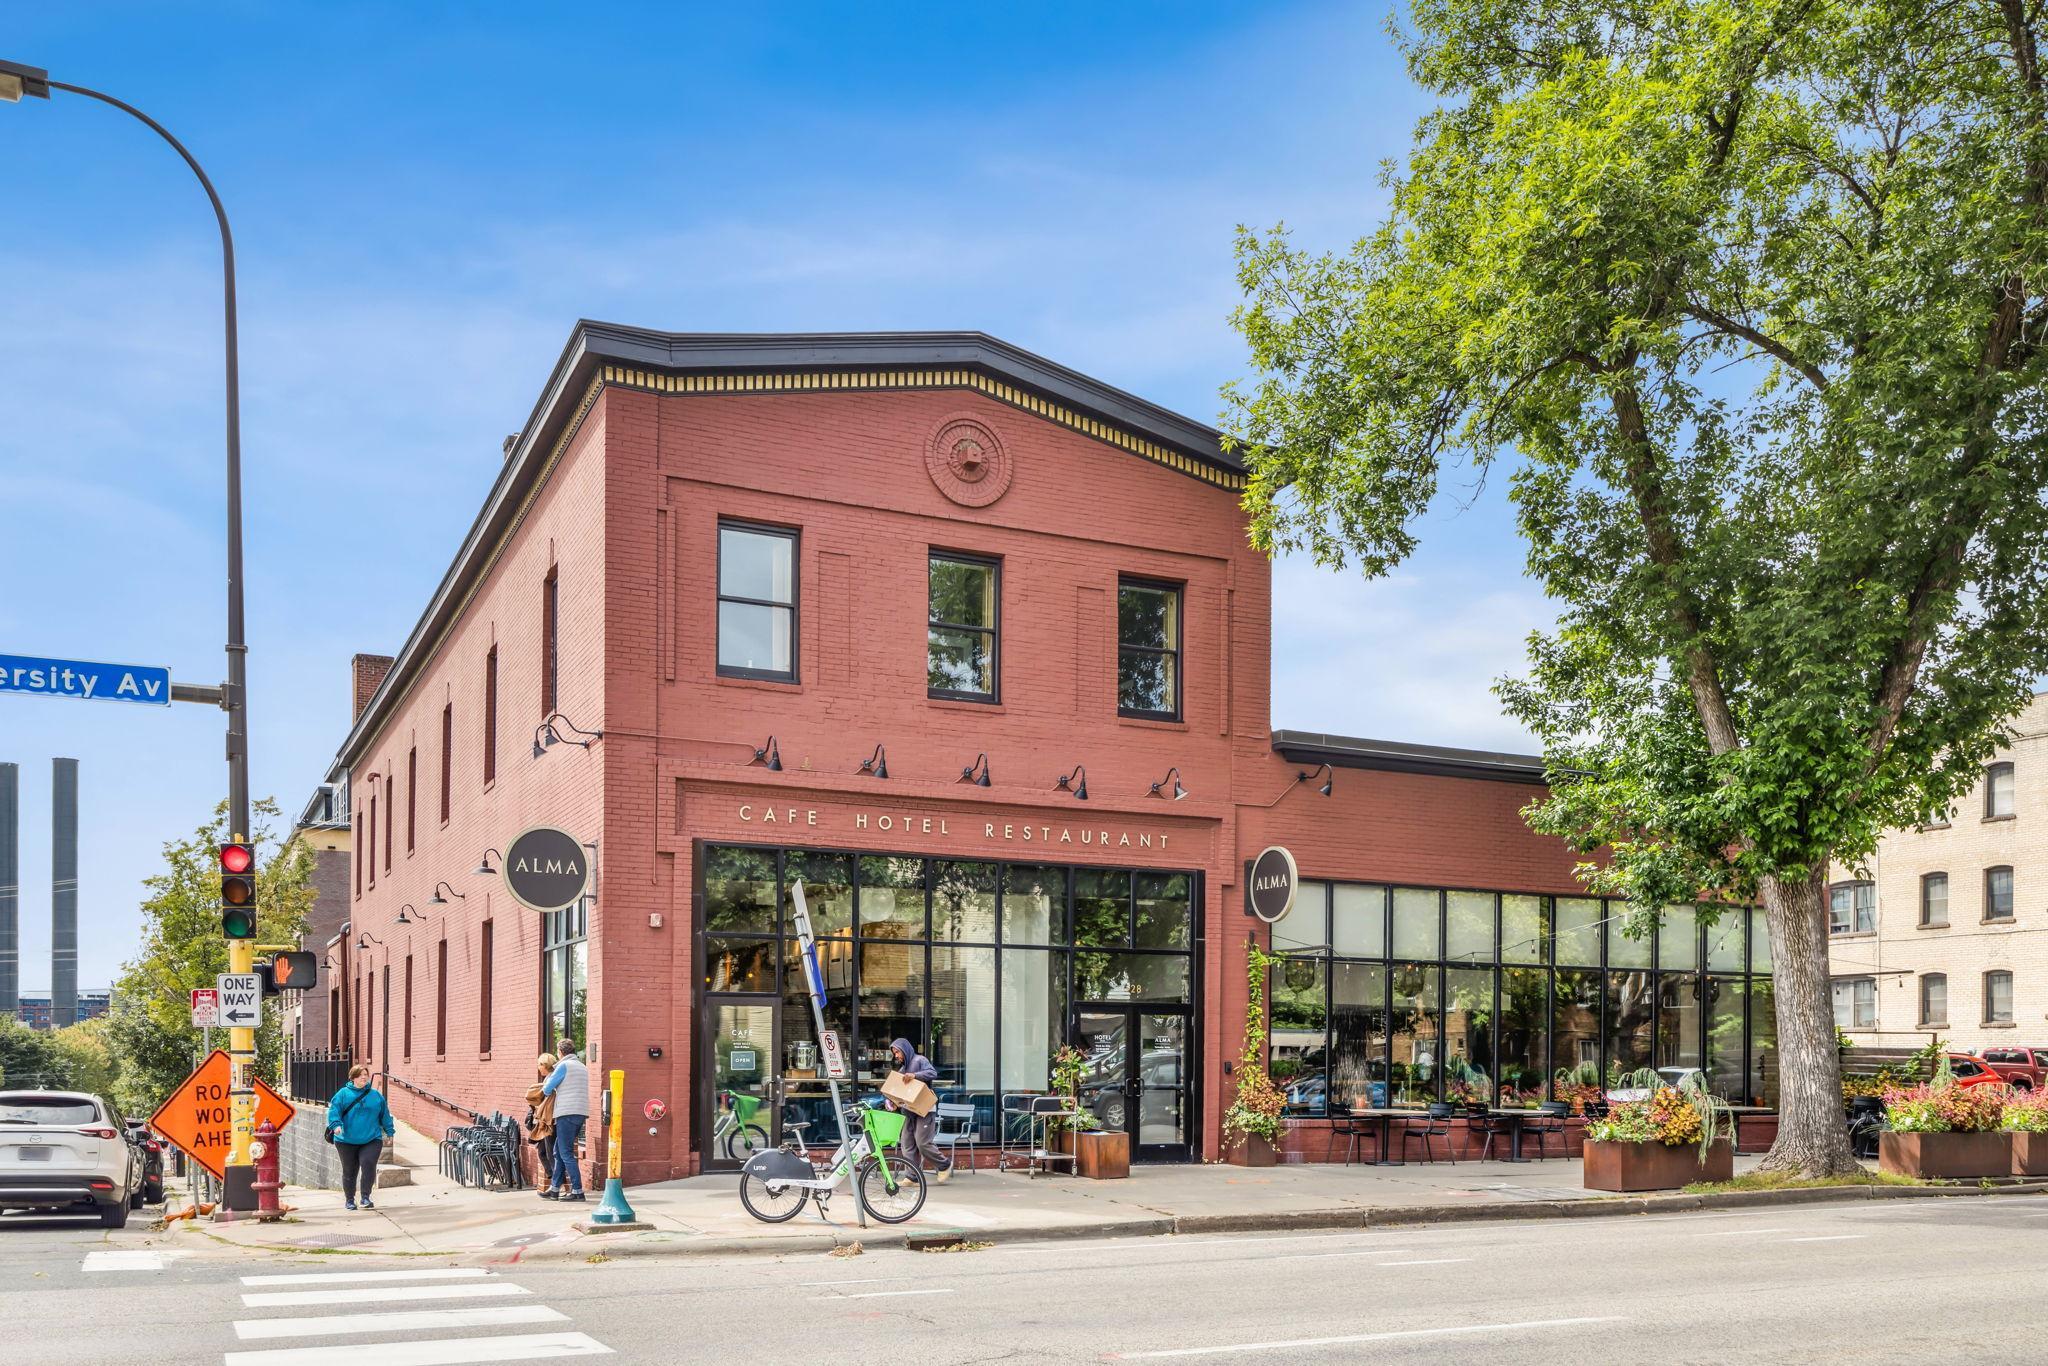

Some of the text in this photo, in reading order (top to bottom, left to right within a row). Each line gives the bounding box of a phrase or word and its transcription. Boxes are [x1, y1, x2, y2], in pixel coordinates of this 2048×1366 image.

[116, 672, 161, 697] Av
[739, 805, 1168, 849] CAFE HOTEL RESTAURANT
[515, 857, 579, 875] ALMA
[1256, 873, 1288, 891] ALMA
[224, 977, 255, 990] ONE
[223, 993, 255, 1006] WAY
[195, 1084, 232, 1102] RO
[195, 1107, 232, 1125] WO
[193, 1130, 232, 1148] AHE
